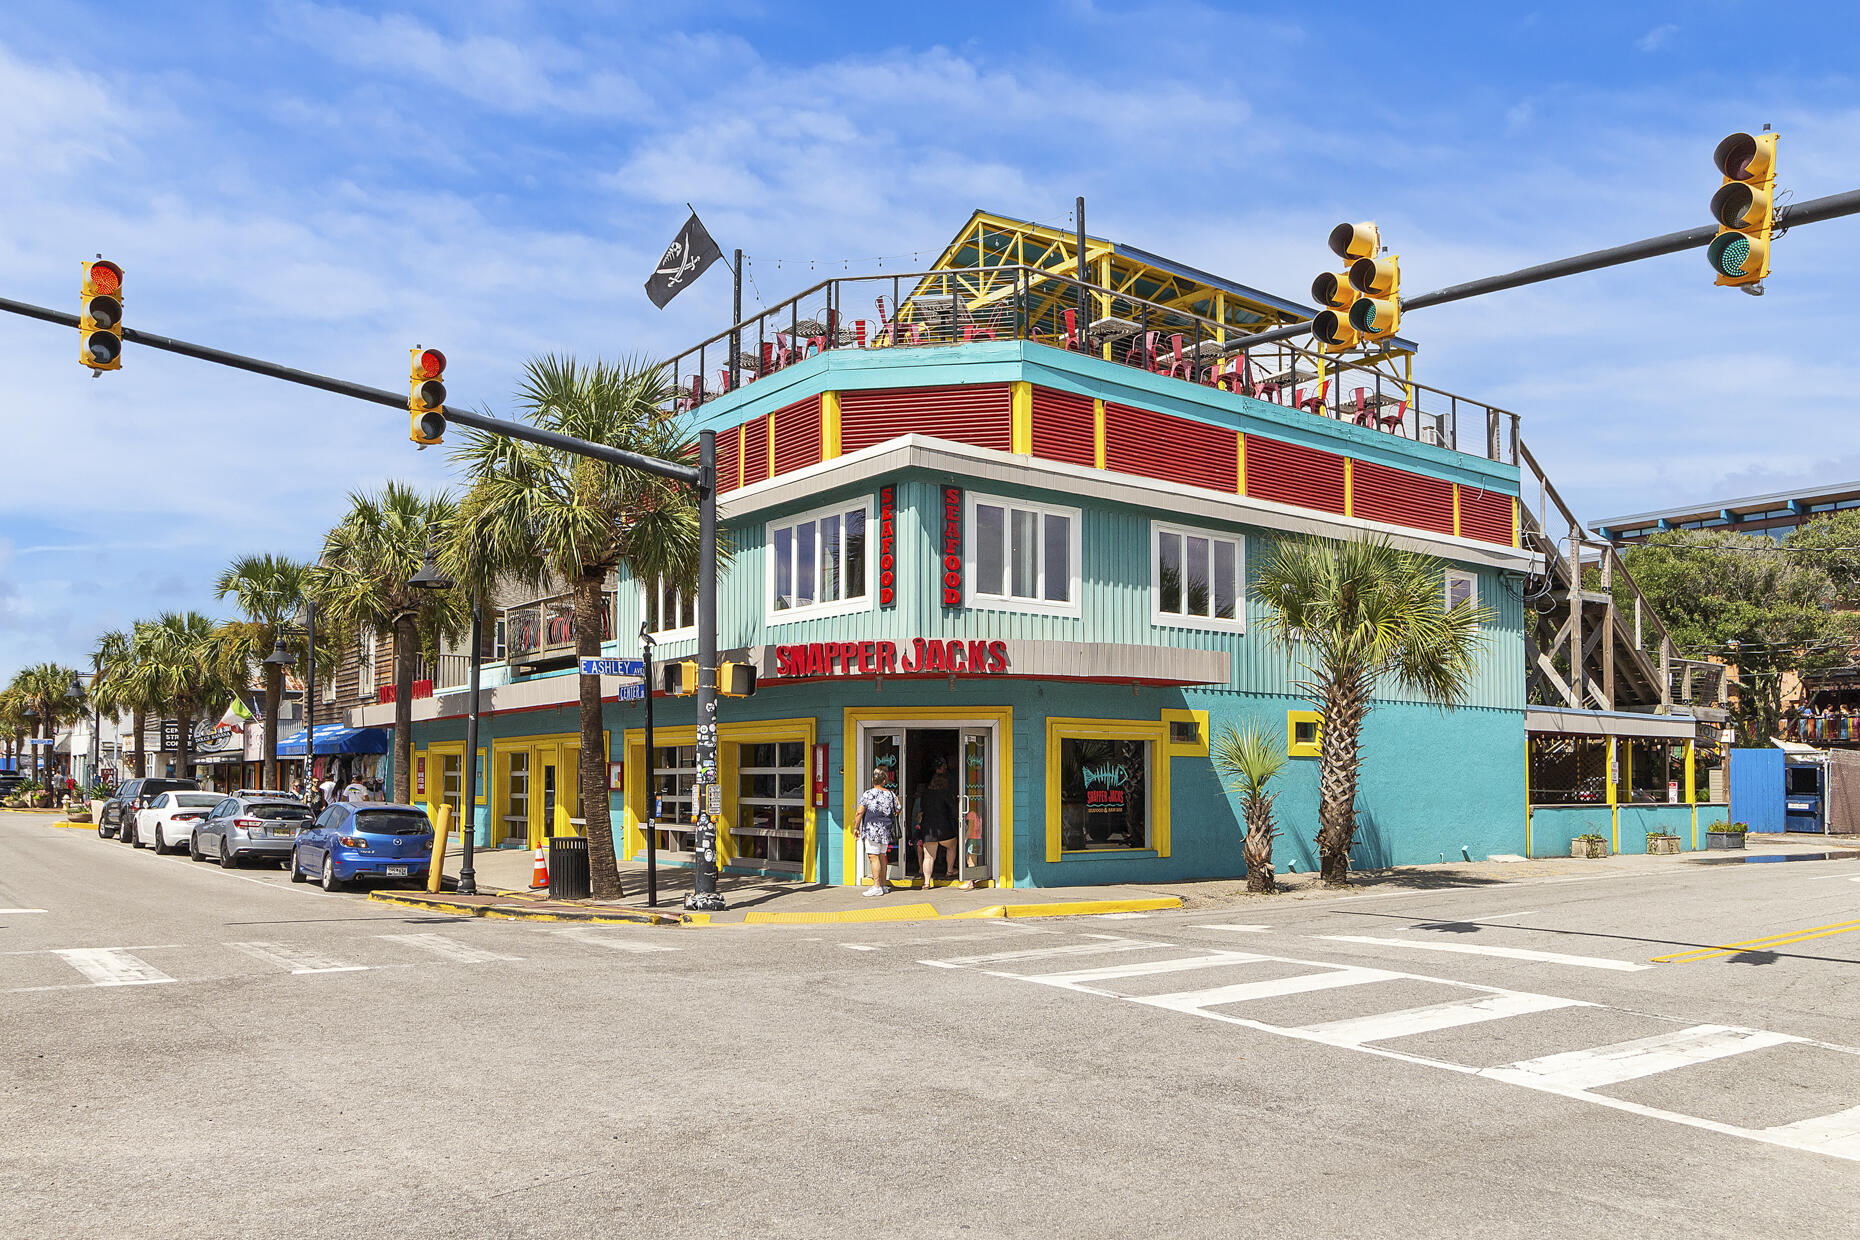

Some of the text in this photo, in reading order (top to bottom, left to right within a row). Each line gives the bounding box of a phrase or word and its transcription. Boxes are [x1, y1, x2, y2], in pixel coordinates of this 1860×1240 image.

[881, 487, 894, 604] SEAFOOD
[944, 488, 961, 604] SEAFOOD
[581, 661, 588, 674] E
[591, 661, 631, 675] ASHLEY
[776, 637, 1007, 676] SNAPPER JACKS
[620, 685, 640, 700] CENTER
[1087, 790, 1124, 804] SNAPPER JACKS
